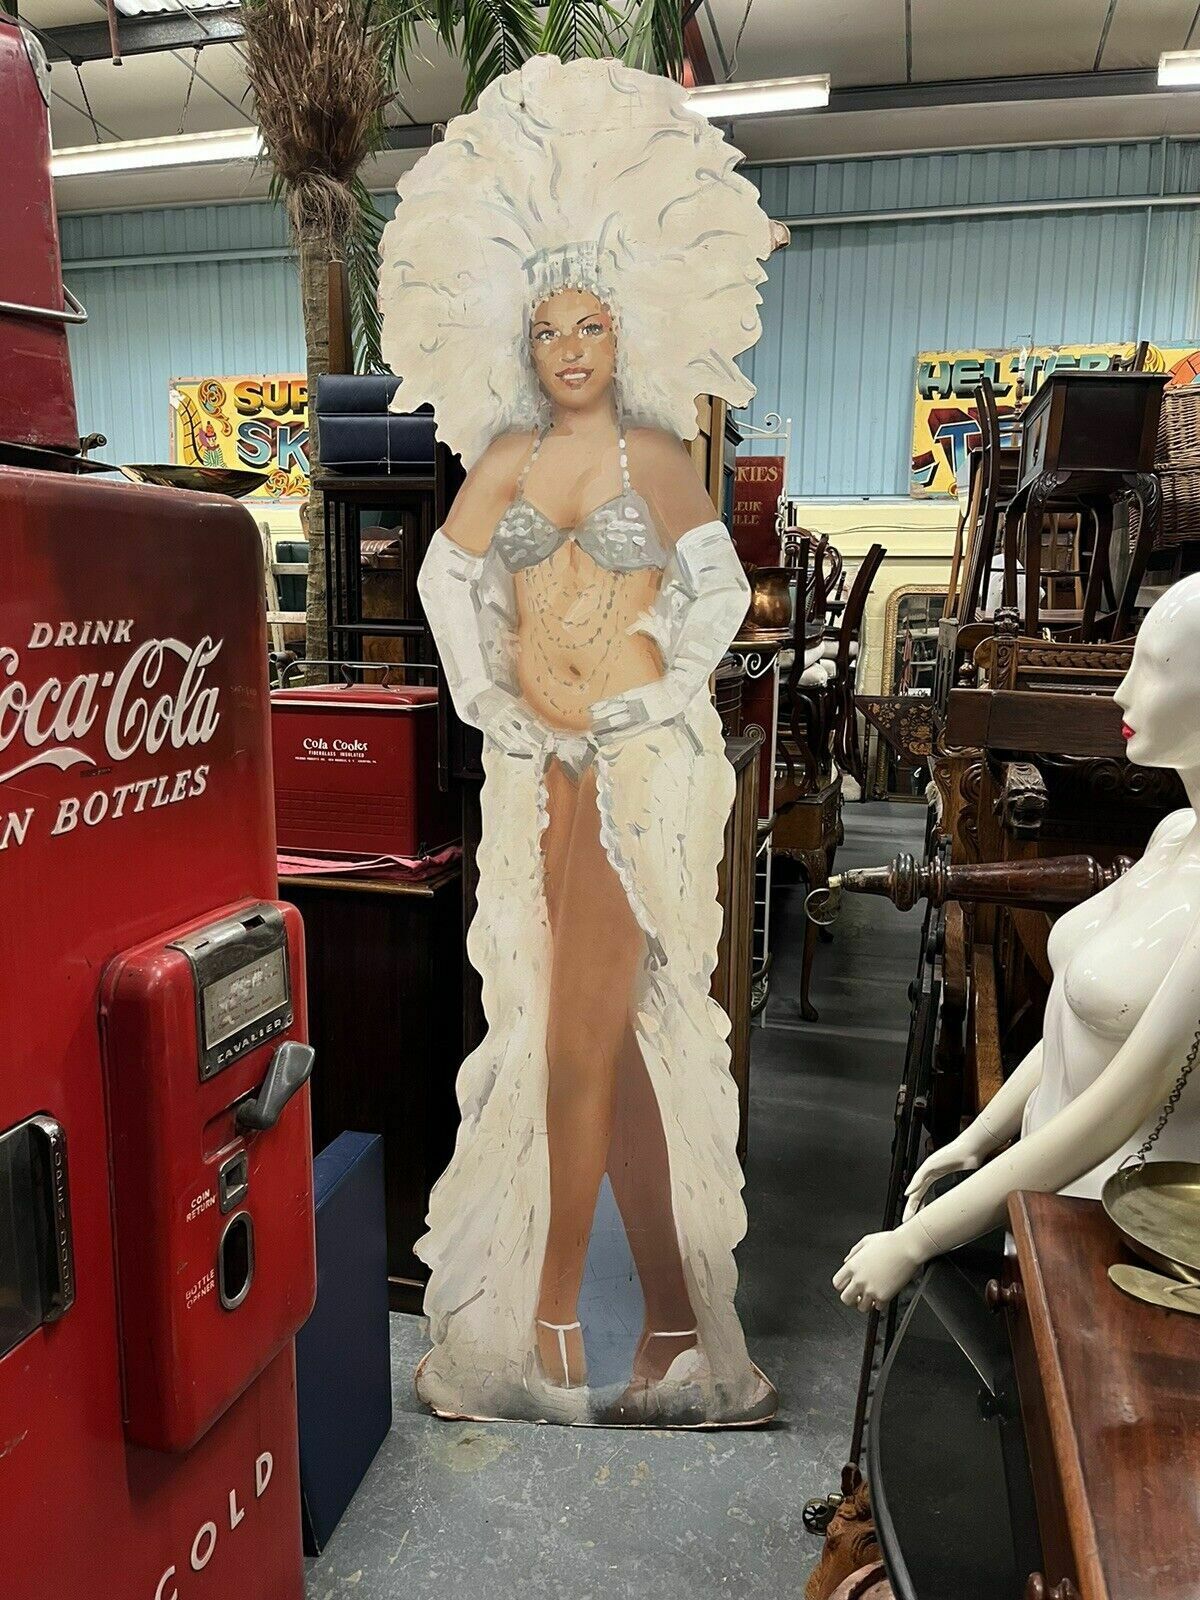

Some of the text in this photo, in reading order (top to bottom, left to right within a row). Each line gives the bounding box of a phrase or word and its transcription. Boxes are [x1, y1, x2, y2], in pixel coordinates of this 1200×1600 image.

[28, 619, 134, 648] DRINK
[303, 738, 328, 750] Cola
[0, 765, 209, 850] N BOTTLES
[217, 1018, 282, 1064] CAVALIER
[186, 1194, 216, 1223] RETURN
[191, 1189, 211, 1208] COIN
[185, 1268, 215, 1301] BOTTLE
[186, 1279, 215, 1310] OPENER
[154, 1451, 273, 1600] COLD
